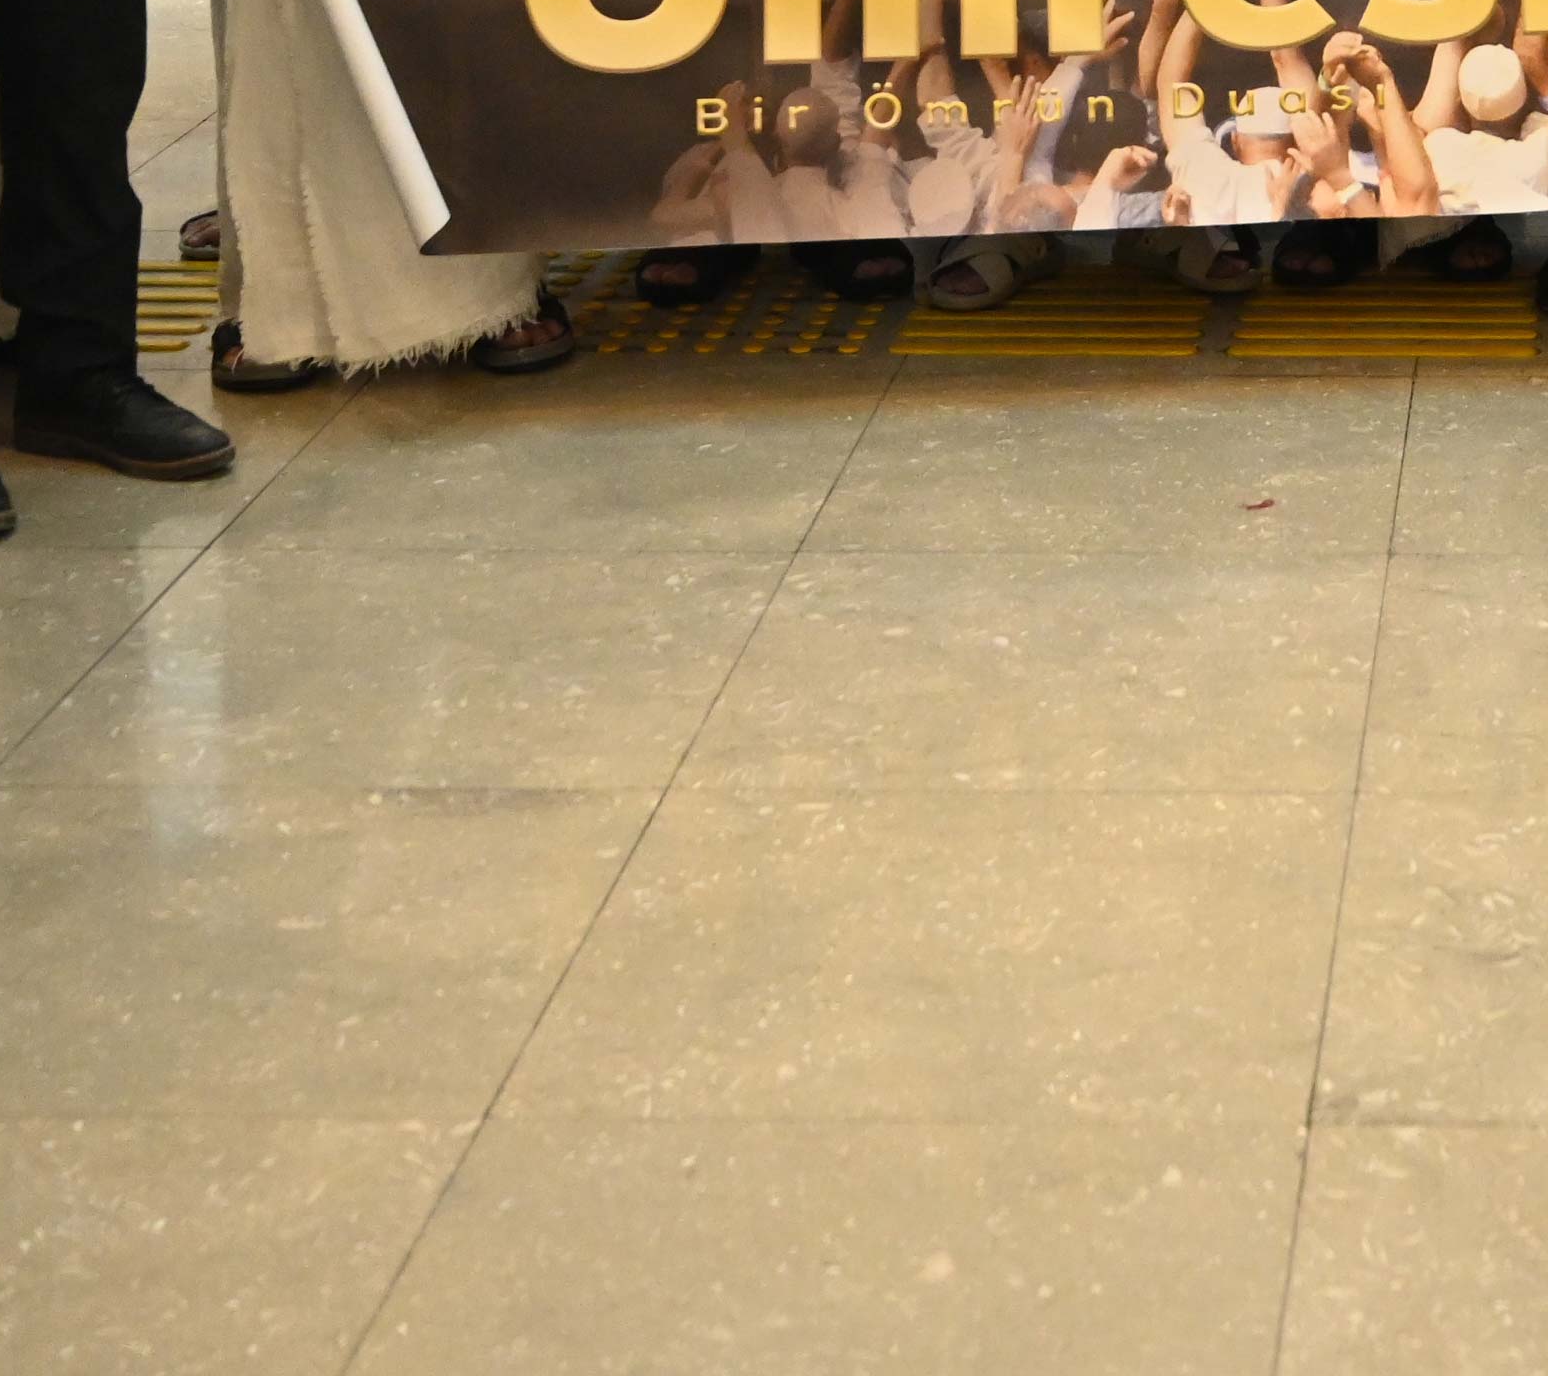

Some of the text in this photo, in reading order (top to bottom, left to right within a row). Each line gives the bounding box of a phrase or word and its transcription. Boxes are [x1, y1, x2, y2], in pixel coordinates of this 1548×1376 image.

[694, 80, 1388, 137] Bir Ömrün Duası
